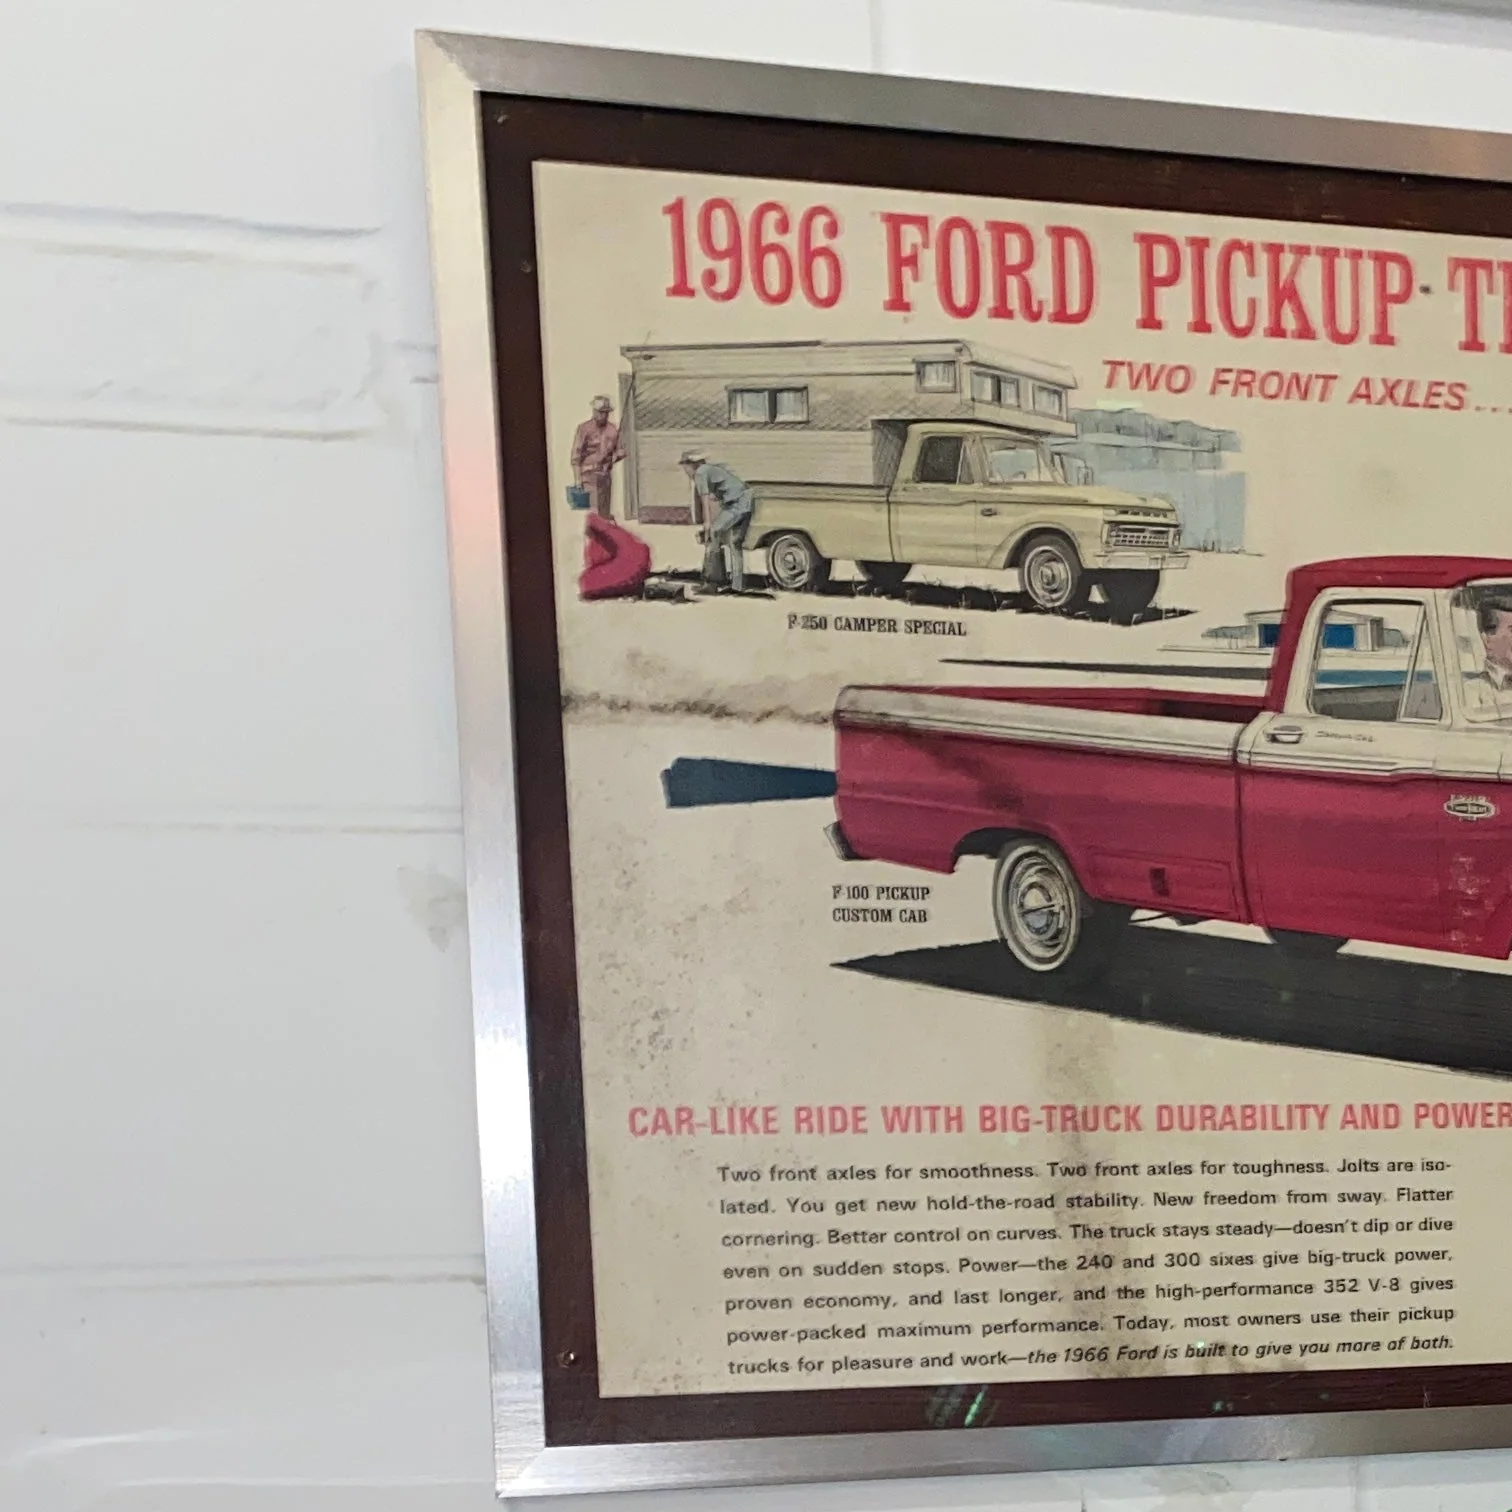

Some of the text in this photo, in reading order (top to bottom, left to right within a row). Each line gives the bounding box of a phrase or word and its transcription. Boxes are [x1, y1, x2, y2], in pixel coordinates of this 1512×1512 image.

[662, 195, 845, 309] 1966
[879, 210, 1096, 325] FORD
[1133, 232, 1414, 346] PICKUP
[1102, 360, 1193, 394] TWO
[1209, 367, 1339, 402] FRONT
[834, 616, 898, 633] CAMPER
[904, 619, 967, 636] SPECIAL
[876, 886, 931, 900] PICKUP
[832, 908, 928, 923] CUSTOM CAB
[629, 1107, 778, 1135] CAR-LIKE
[795, 1106, 868, 1133] RIDE
[881, 1105, 963, 1133] WITH
[979, 1105, 1142, 1133] BIG-TRUCK
[1156, 1104, 1329, 1131] DURABILITY
[1340, 1103, 1400, 1130] AND
[716, 1158, 1452, 1182] Two front axles for smoothness. Two front axles for toughness. Jolts are iso-
[720, 1187, 1455, 1216] lated. You get new hold-the-road stability. New freedom from sway. Flatter
[721, 1231, 821, 1248] cornering.
[827, 1228, 889, 1245] Better
[893, 1227, 961, 1243] control
[966, 1229, 992, 1242] on
[996, 1228, 1062, 1241] curves.
[1068, 1223, 1107, 1240] The
[1108, 1223, 1157, 1239] truck
[1162, 1224, 1211, 1239] stays
[1363, 1218, 1390, 1236] dip
[1395, 1220, 1414, 1232] or
[1417, 1216, 1455, 1232] dive
[722, 1266, 770, 1279] even
[778, 1265, 804, 1278] on
[812, 1260, 884, 1277] sudden
[892, 1262, 950, 1277] stops.
[1075, 1254, 1116, 1271] 240
[1122, 1254, 1155, 1269] and
[1163, 1252, 1201, 1268] 300
[1209, 1252, 1257, 1267] sixes
[1262, 1250, 1300, 1269] give
[1307, 1249, 1386, 1267] big-truck
[1394, 1249, 1453, 1265] power,
[725, 1277, 1456, 1315] proven economy, and last longer, and the high-performance 352 V-8 gives
[726, 1306, 1457, 1345] power-packed maximum performance. Today, most owners use their pickup
[727, 1358, 793, 1376] trucks
[797, 1356, 825, 1373] for
[831, 1356, 915, 1374] pleasure
[920, 1352, 954, 1368] and
[1064, 1346, 1110, 1363] 1966
[1116, 1344, 1160, 1361] Ford
[1163, 1344, 1179, 1360] is
[1184, 1341, 1227, 1360] built
[1231, 1342, 1250, 1358] to
[1255, 1341, 1294, 1359] give
[1298, 1342, 1330, 1358] you
[1335, 1340, 1382, 1354] more
[1386, 1336, 1408, 1352] of
[1409, 1335, 1454, 1351] both.
